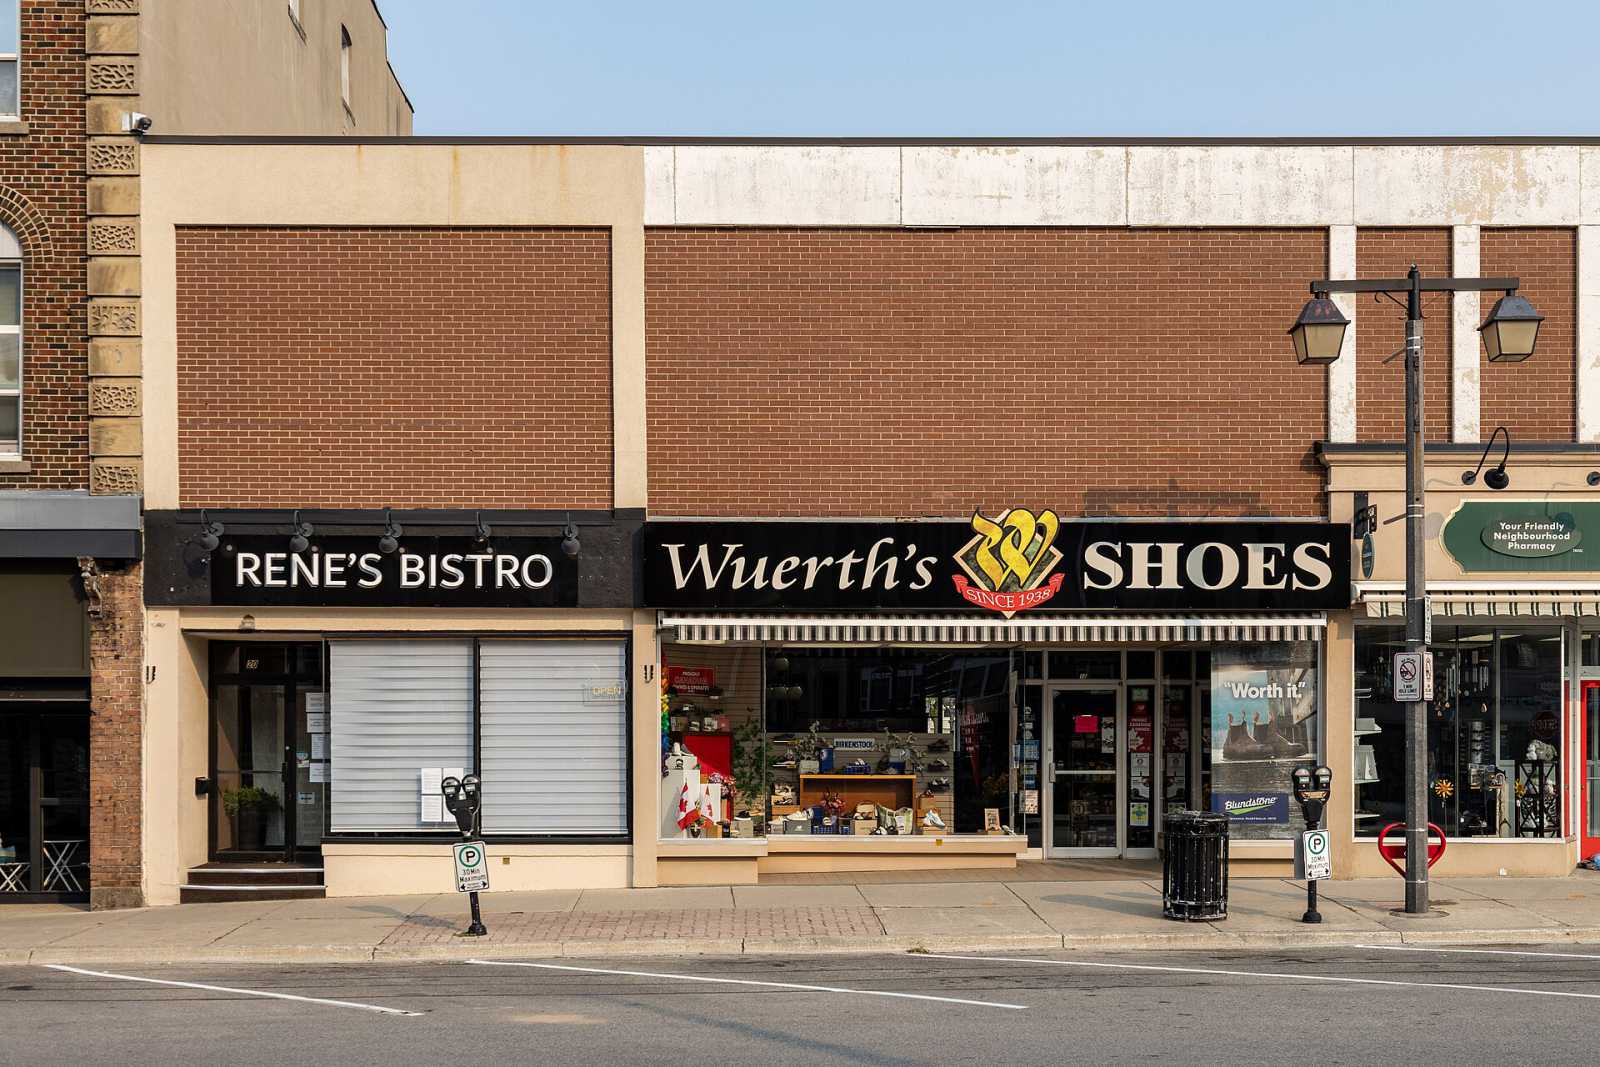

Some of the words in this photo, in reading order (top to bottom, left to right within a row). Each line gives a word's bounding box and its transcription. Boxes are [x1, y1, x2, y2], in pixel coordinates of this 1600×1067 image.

[1500, 522, 1521, 530] Your
[1524, 522, 1564, 531] Friendly
[1493, 532, 1571, 541] Neighbourhood
[1508, 541, 1556, 551] Pharmacy
[661, 537, 938, 590] Wuerth's
[1083, 541, 1332, 591] SHOES
[235, 552, 384, 588] RENE'S
[400, 553, 553, 589] BISTRO
[966, 589, 1015, 608] SINCE
[1018, 589, 1051, 606] 1938
[1223, 681, 1283, 699] "Worth
[1225, 797, 1276, 810] Blundstone
[1314, 838, 1322, 850] P
[465, 851, 476, 862] P
